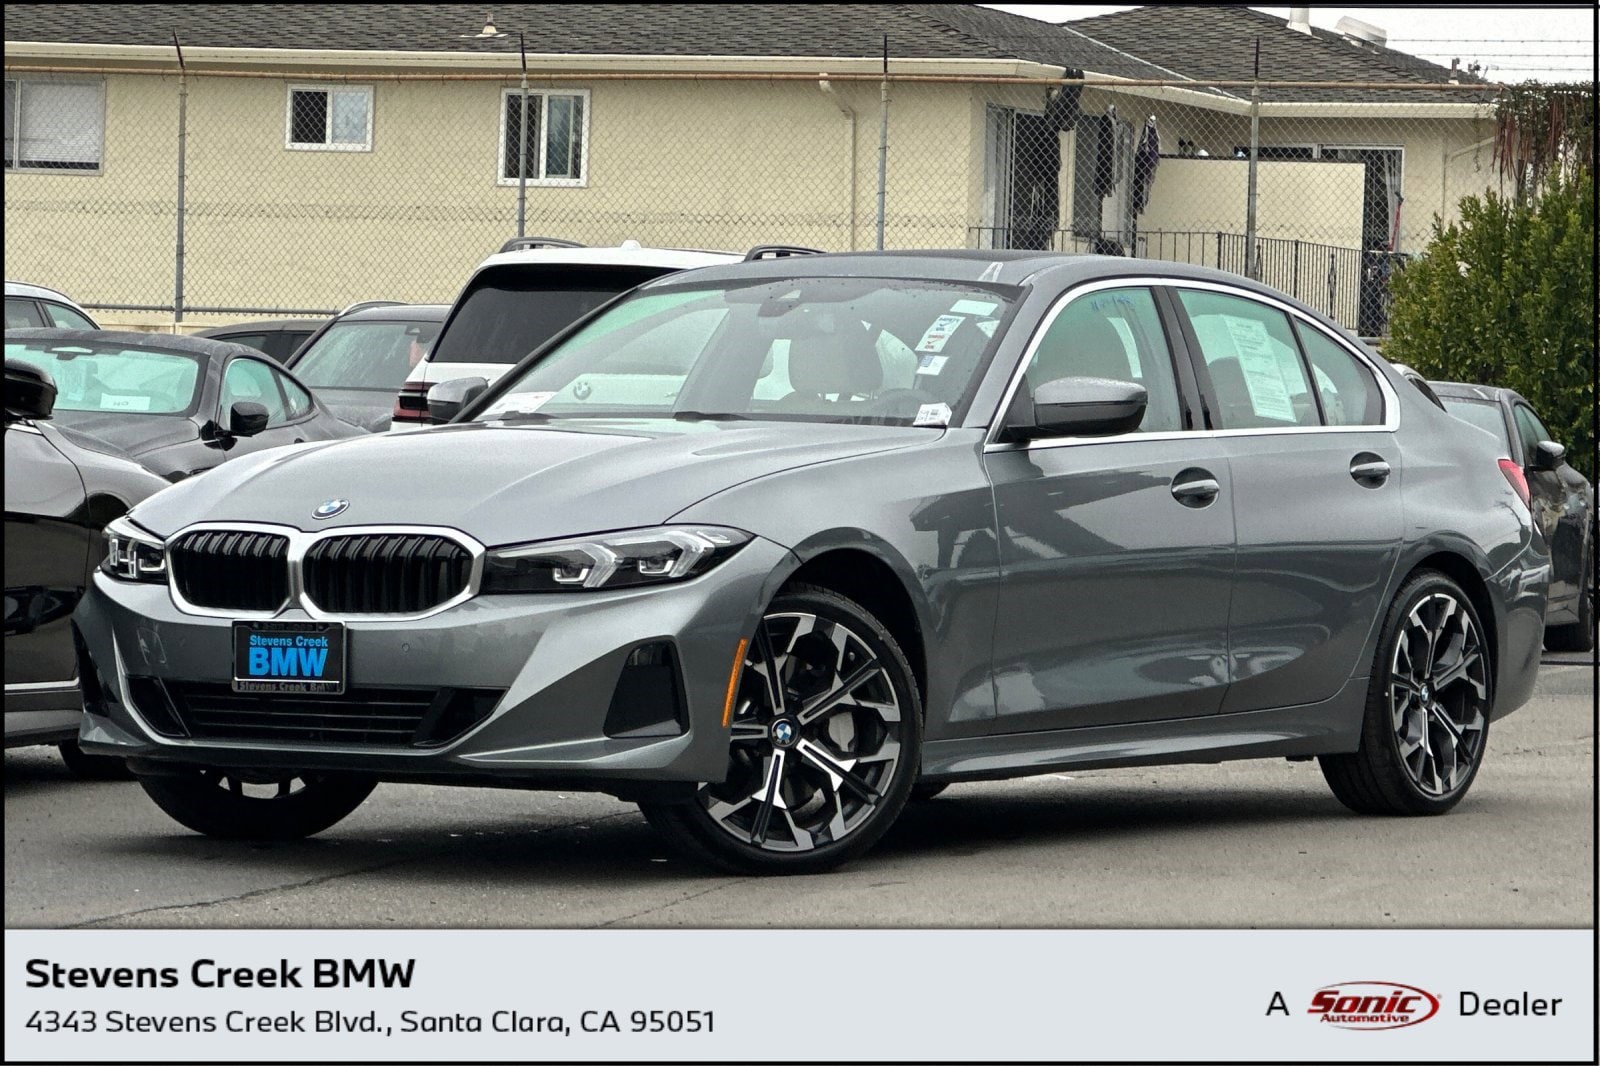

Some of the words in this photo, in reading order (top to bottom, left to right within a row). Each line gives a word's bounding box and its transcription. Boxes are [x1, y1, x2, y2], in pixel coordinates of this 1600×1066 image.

[249, 634, 293, 647] Stevens
[295, 635, 329, 647] Creek
[248, 646, 329, 677] BMW
